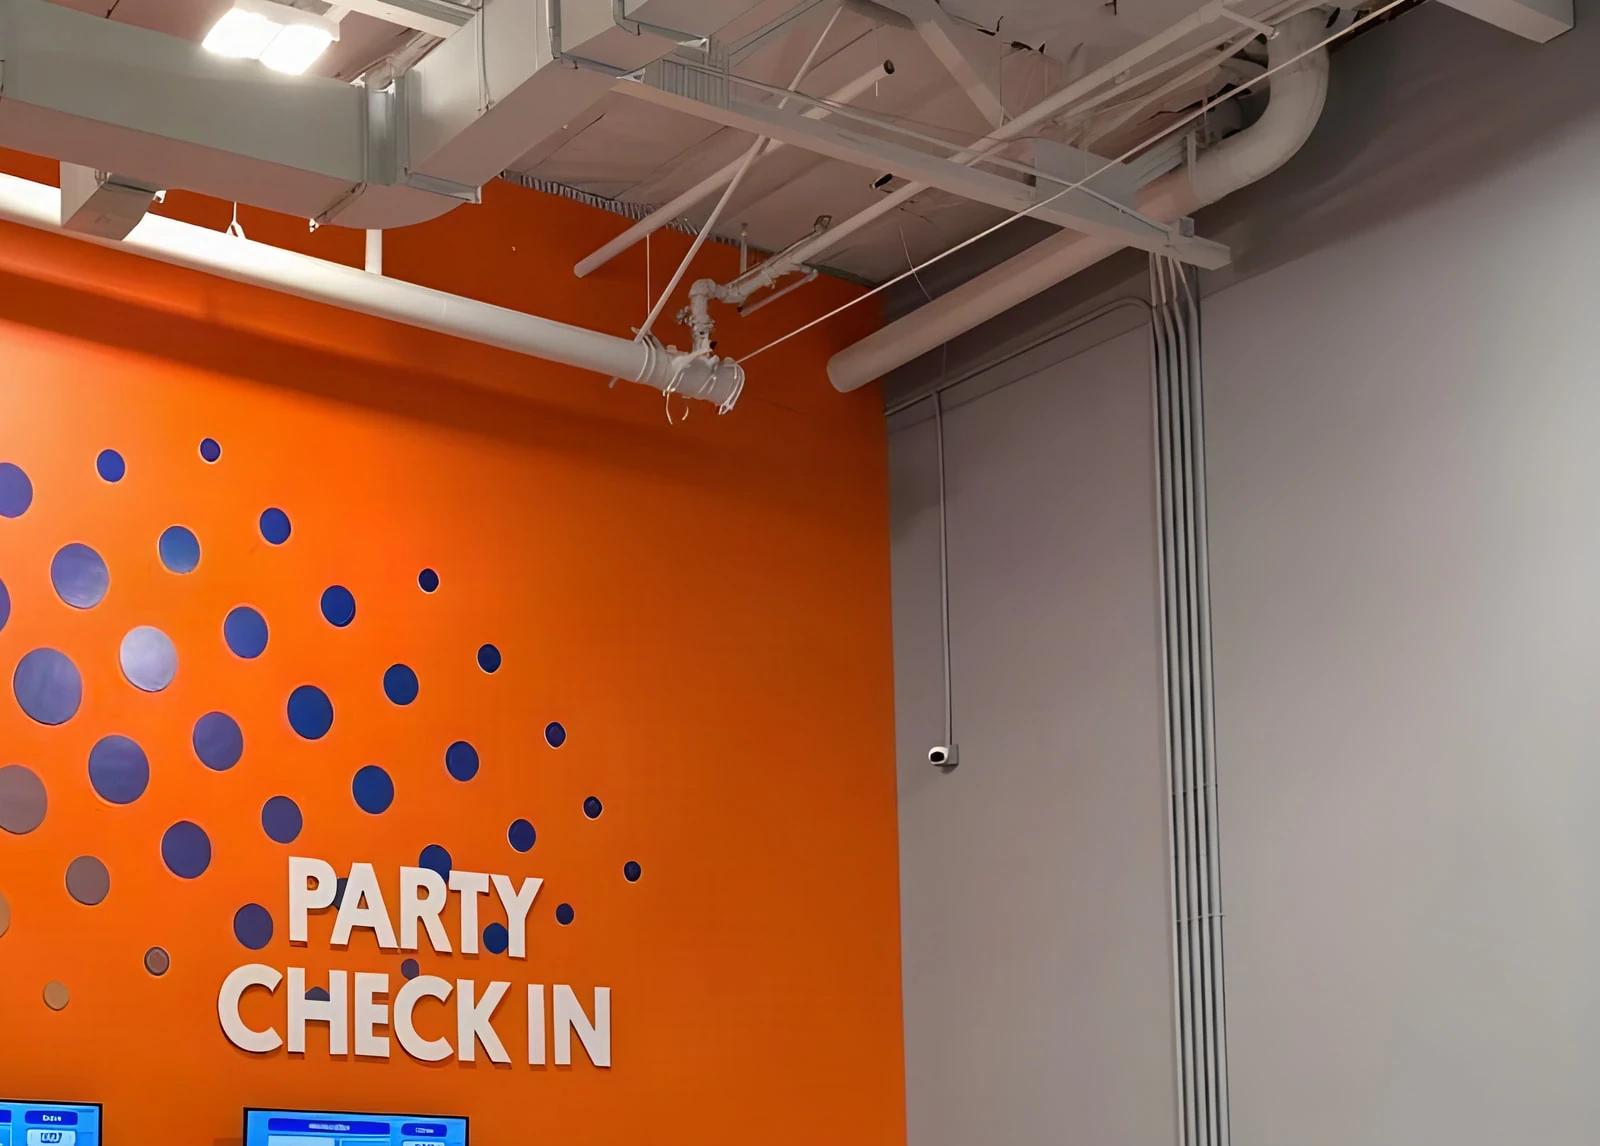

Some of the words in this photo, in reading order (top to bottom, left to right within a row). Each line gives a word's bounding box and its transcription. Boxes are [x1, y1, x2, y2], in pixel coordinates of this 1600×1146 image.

[288, 856, 544, 958] PARTY
[217, 963, 512, 1064] CHECK
[527, 983, 611, 1067] IN
